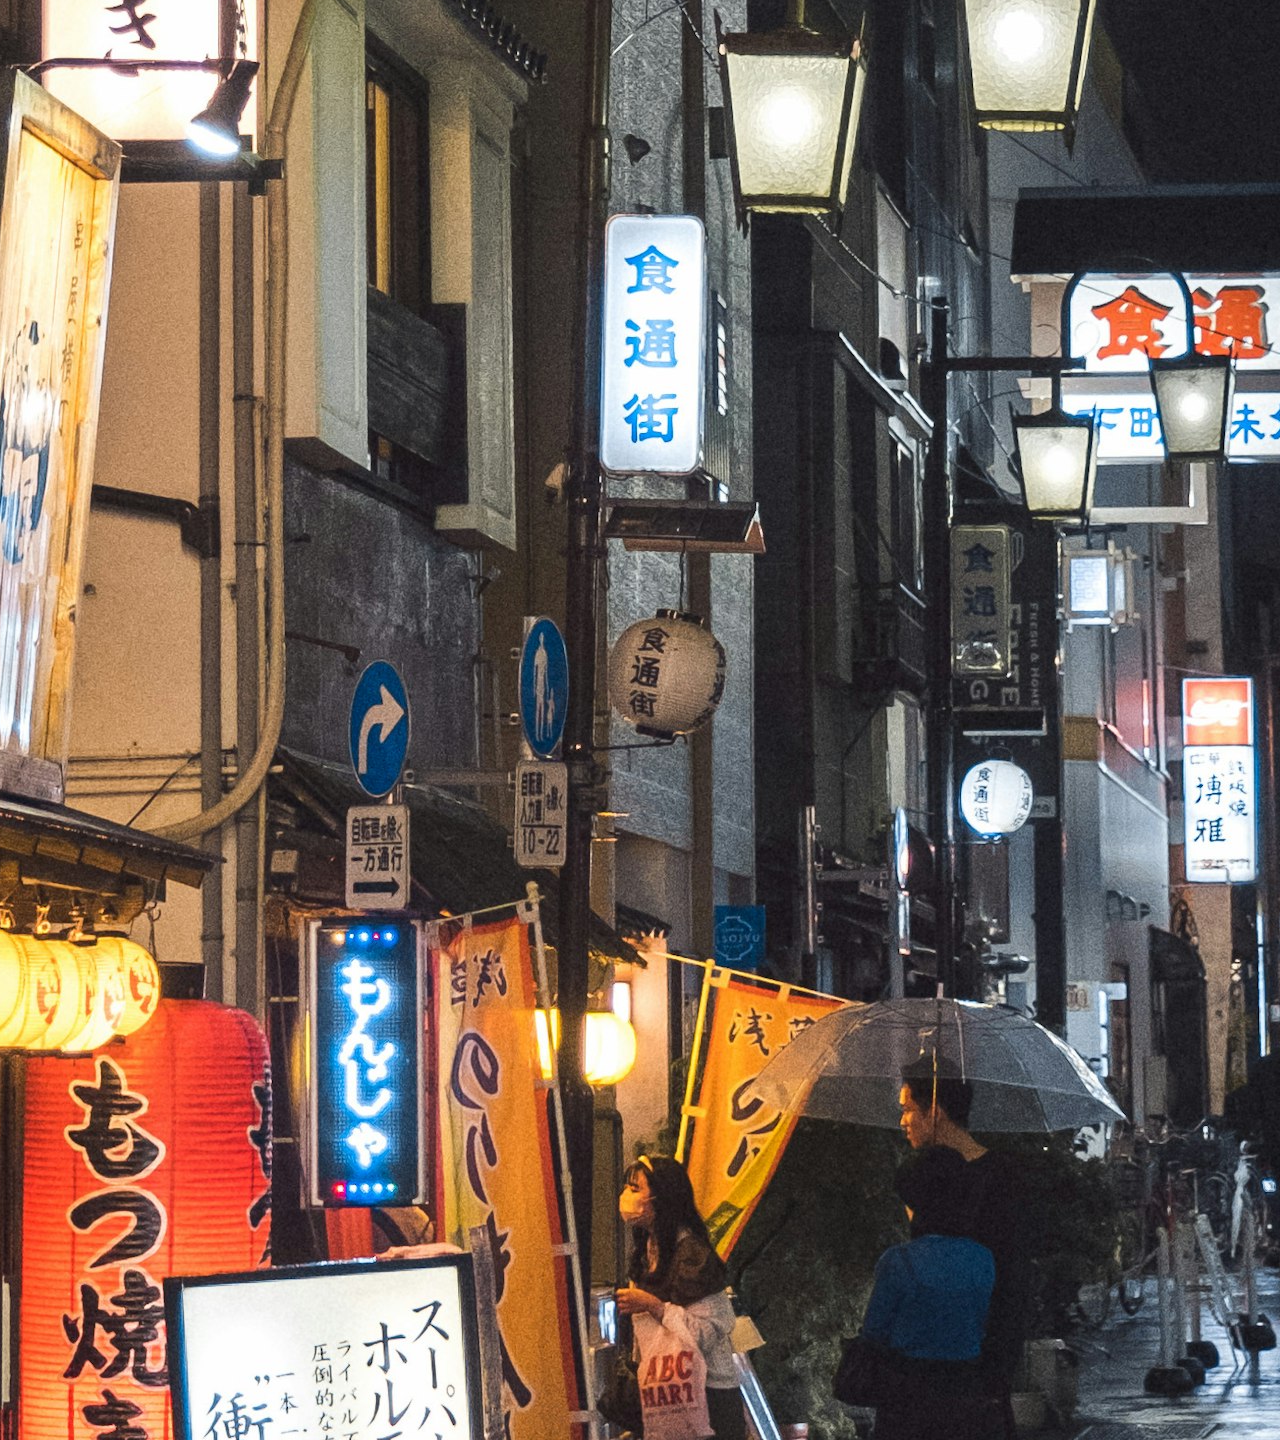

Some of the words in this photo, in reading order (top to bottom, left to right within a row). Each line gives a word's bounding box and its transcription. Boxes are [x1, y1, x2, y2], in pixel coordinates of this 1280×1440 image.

[623, 245, 679, 445] 食通街
[629, 626, 670, 718] 食通街
[973, 767, 992, 824] 食通街
[352, 815, 403, 842] 自転車を除く
[351, 846, 403, 873] 一方通行
[338, 957, 398, 1172] もんじゃ
[643, 1349, 694, 1386] ABC
[642, 1382, 695, 1408] MART
